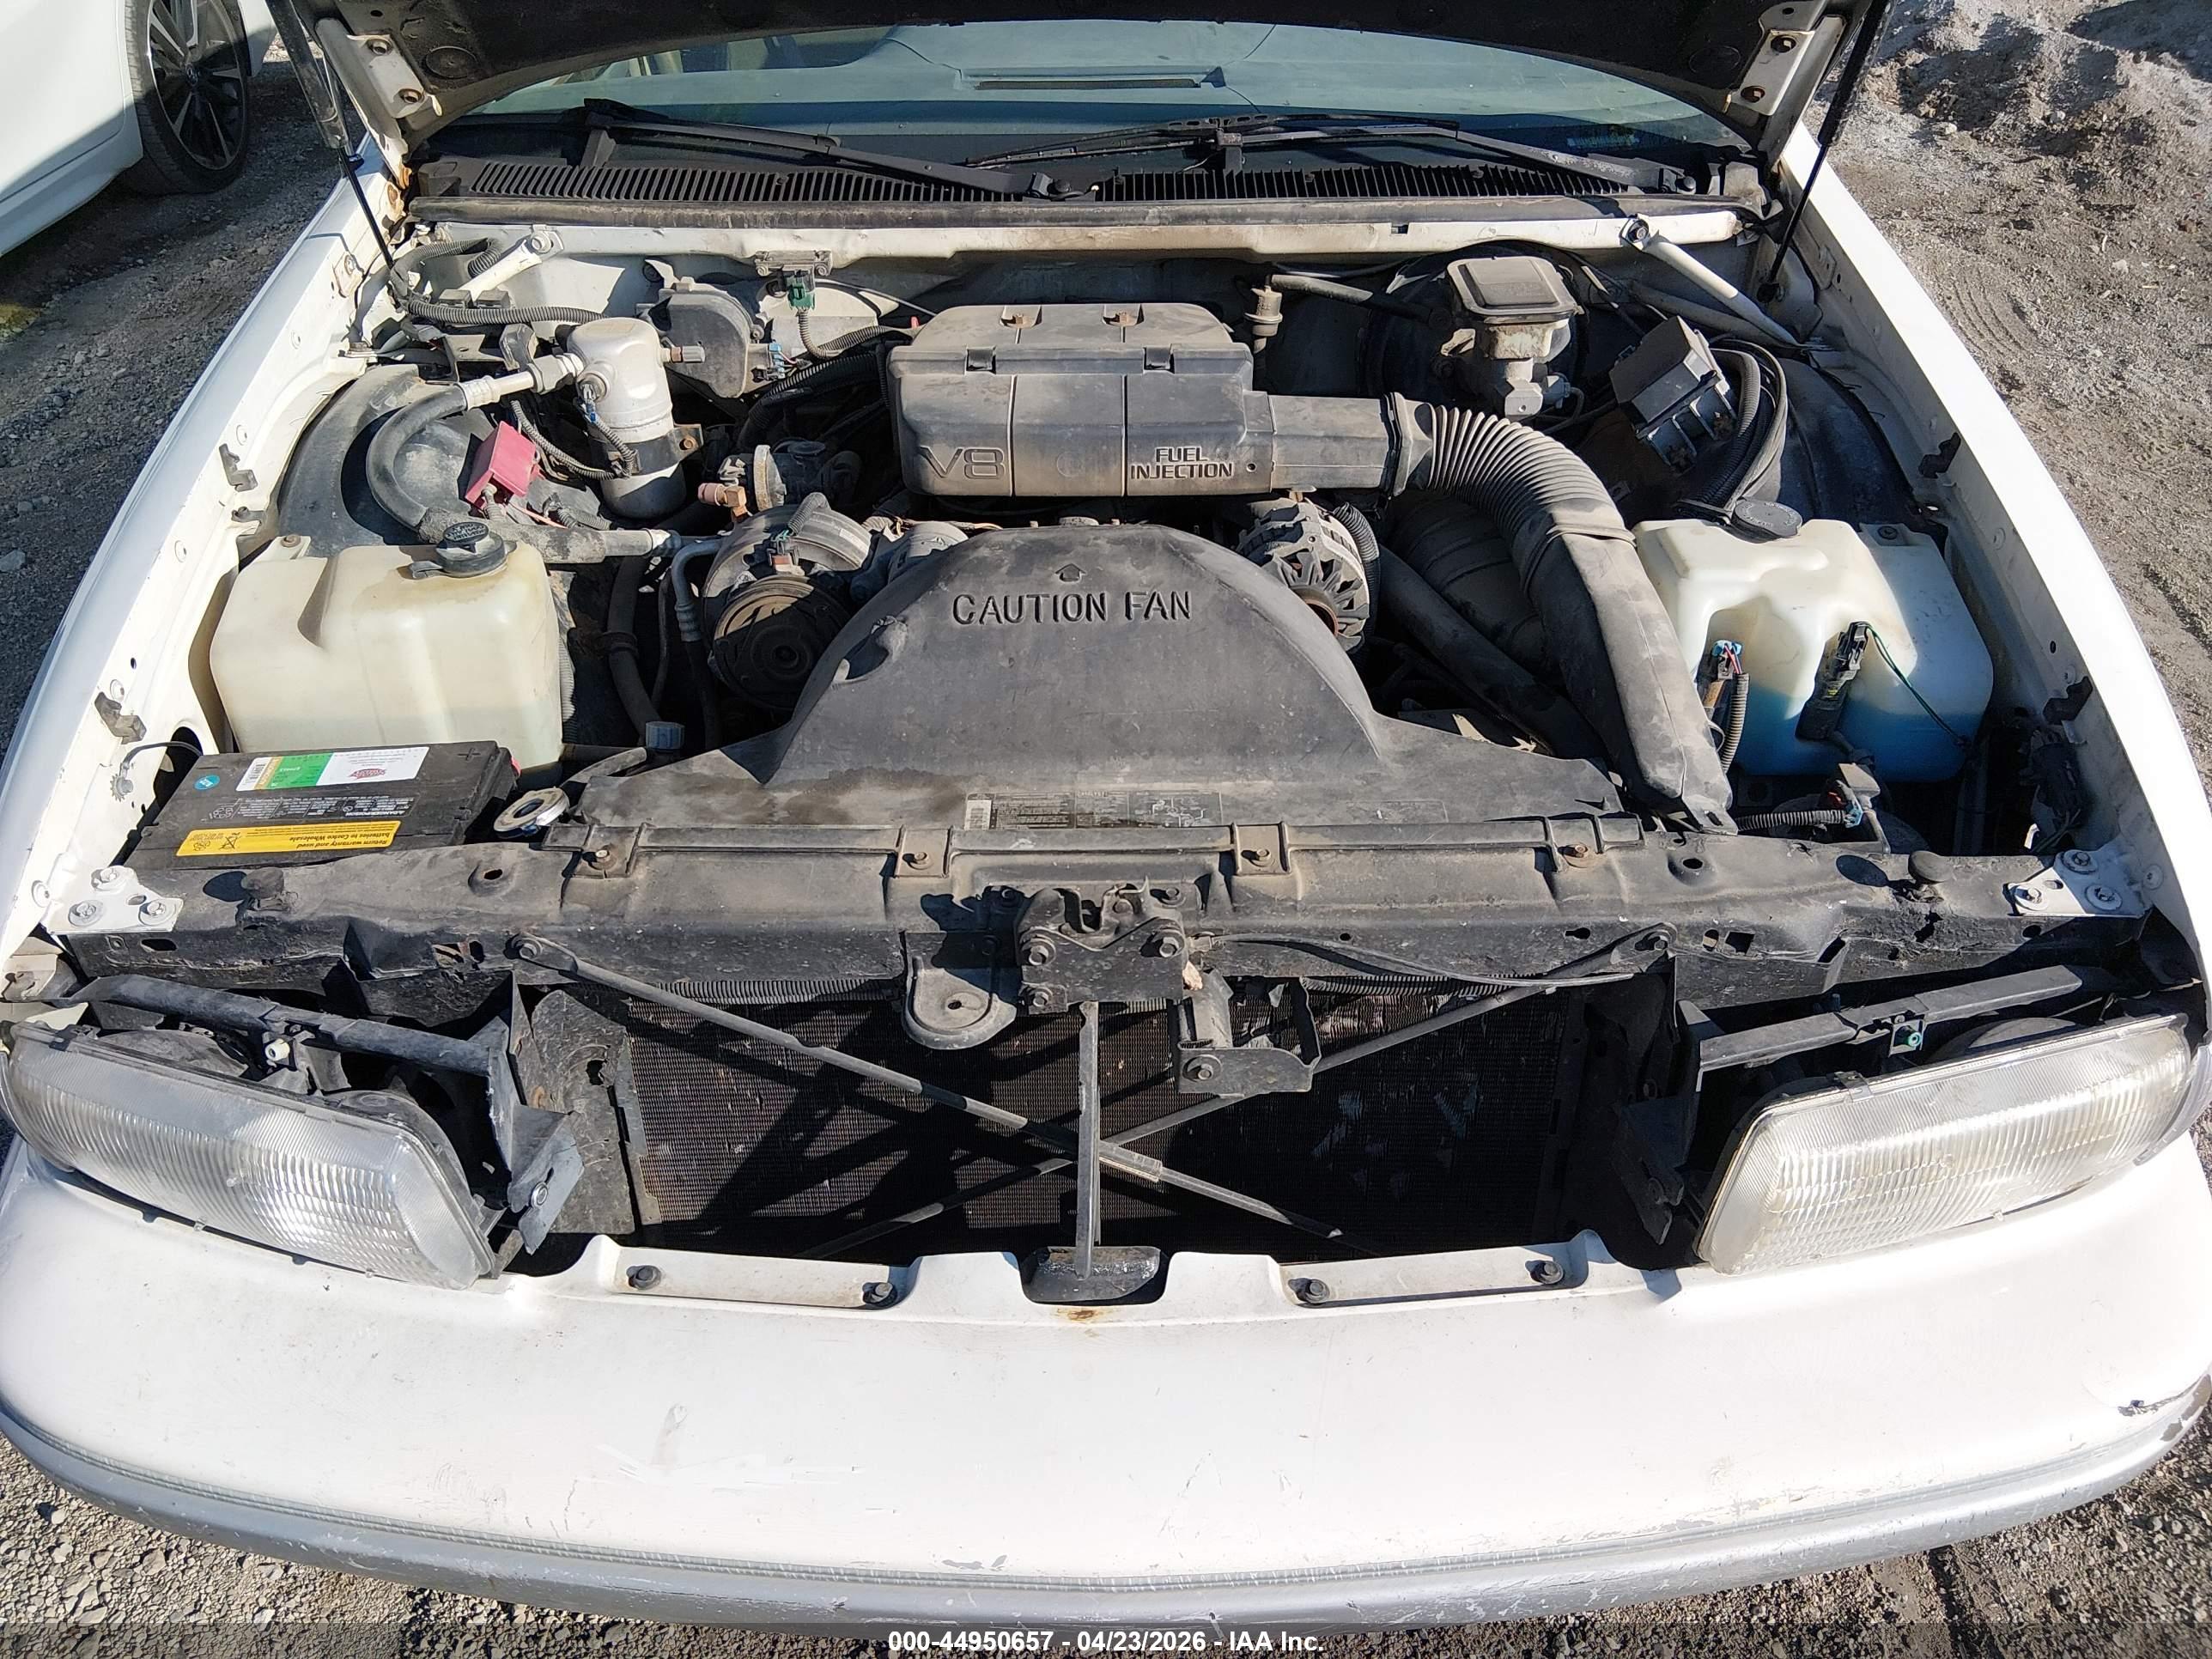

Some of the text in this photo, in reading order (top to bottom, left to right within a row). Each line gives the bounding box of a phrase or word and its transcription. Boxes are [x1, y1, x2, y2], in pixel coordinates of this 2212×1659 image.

[921, 446, 1006, 480] V8
[1155, 446, 1209, 463] FUEL
[1130, 462, 1234, 479] INJECTION
[952, 590, 1192, 625] CAUTION FAN
